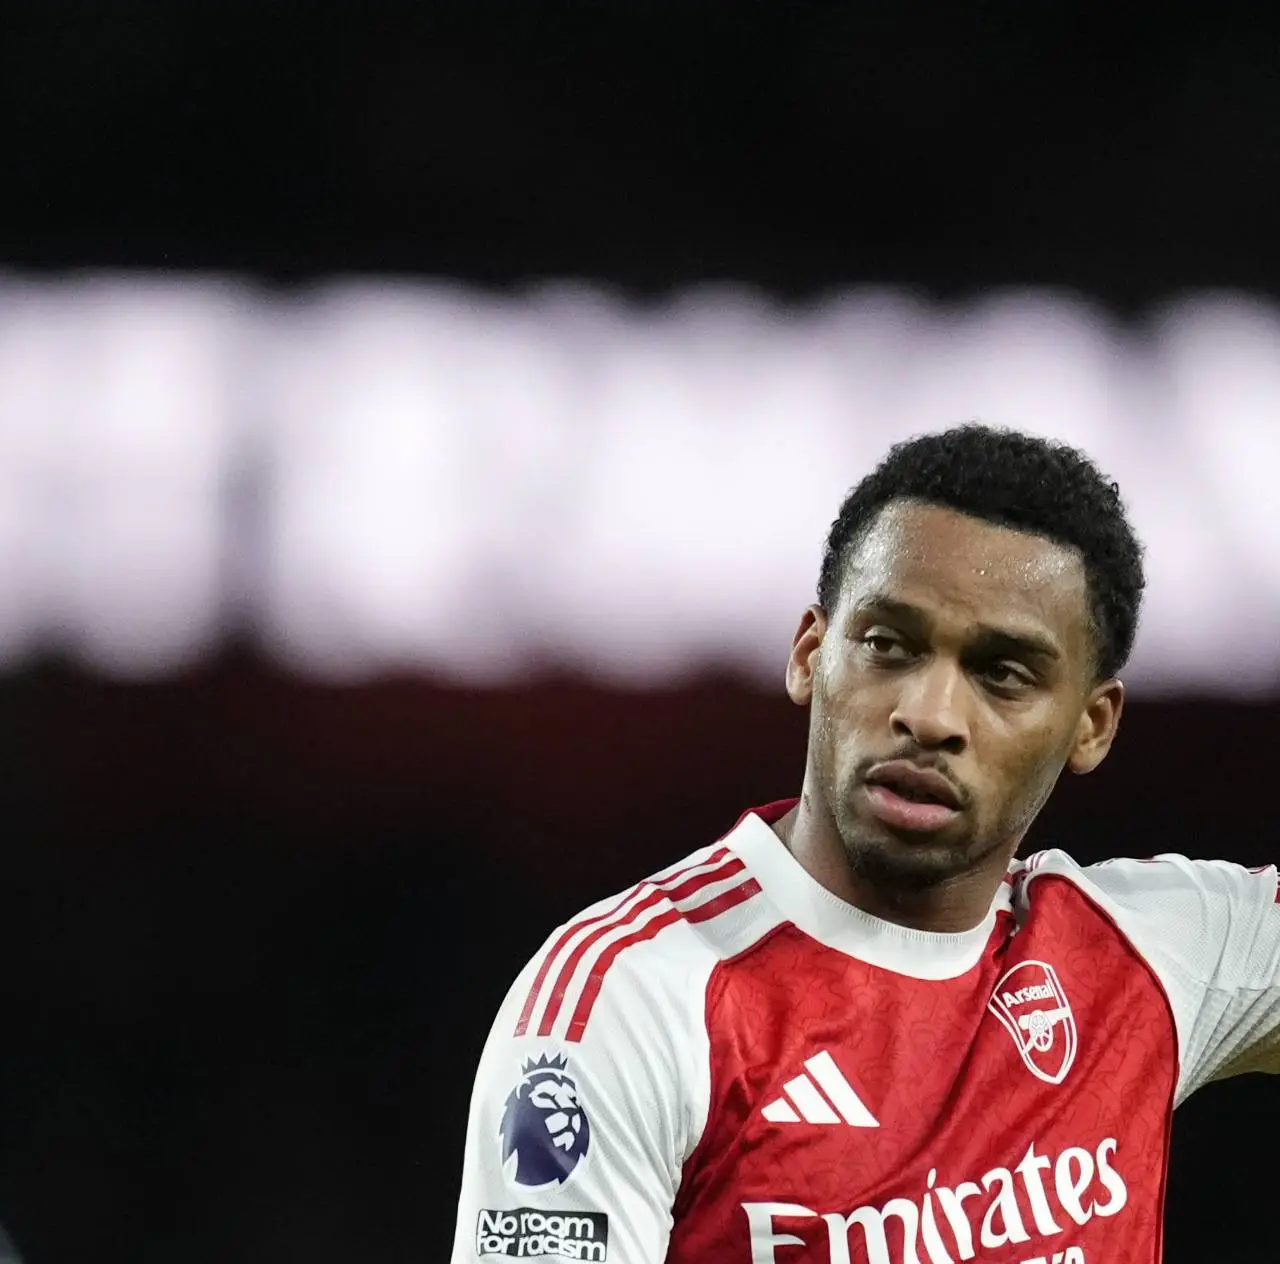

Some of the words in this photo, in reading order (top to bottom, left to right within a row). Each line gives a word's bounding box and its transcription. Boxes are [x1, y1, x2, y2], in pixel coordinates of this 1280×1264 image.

[1002, 979, 1056, 1008] Arsenal
[479, 1210, 518, 1235] No
[520, 1213, 594, 1239] room
[477, 1230, 515, 1256] for
[517, 1235, 606, 1262] racism
